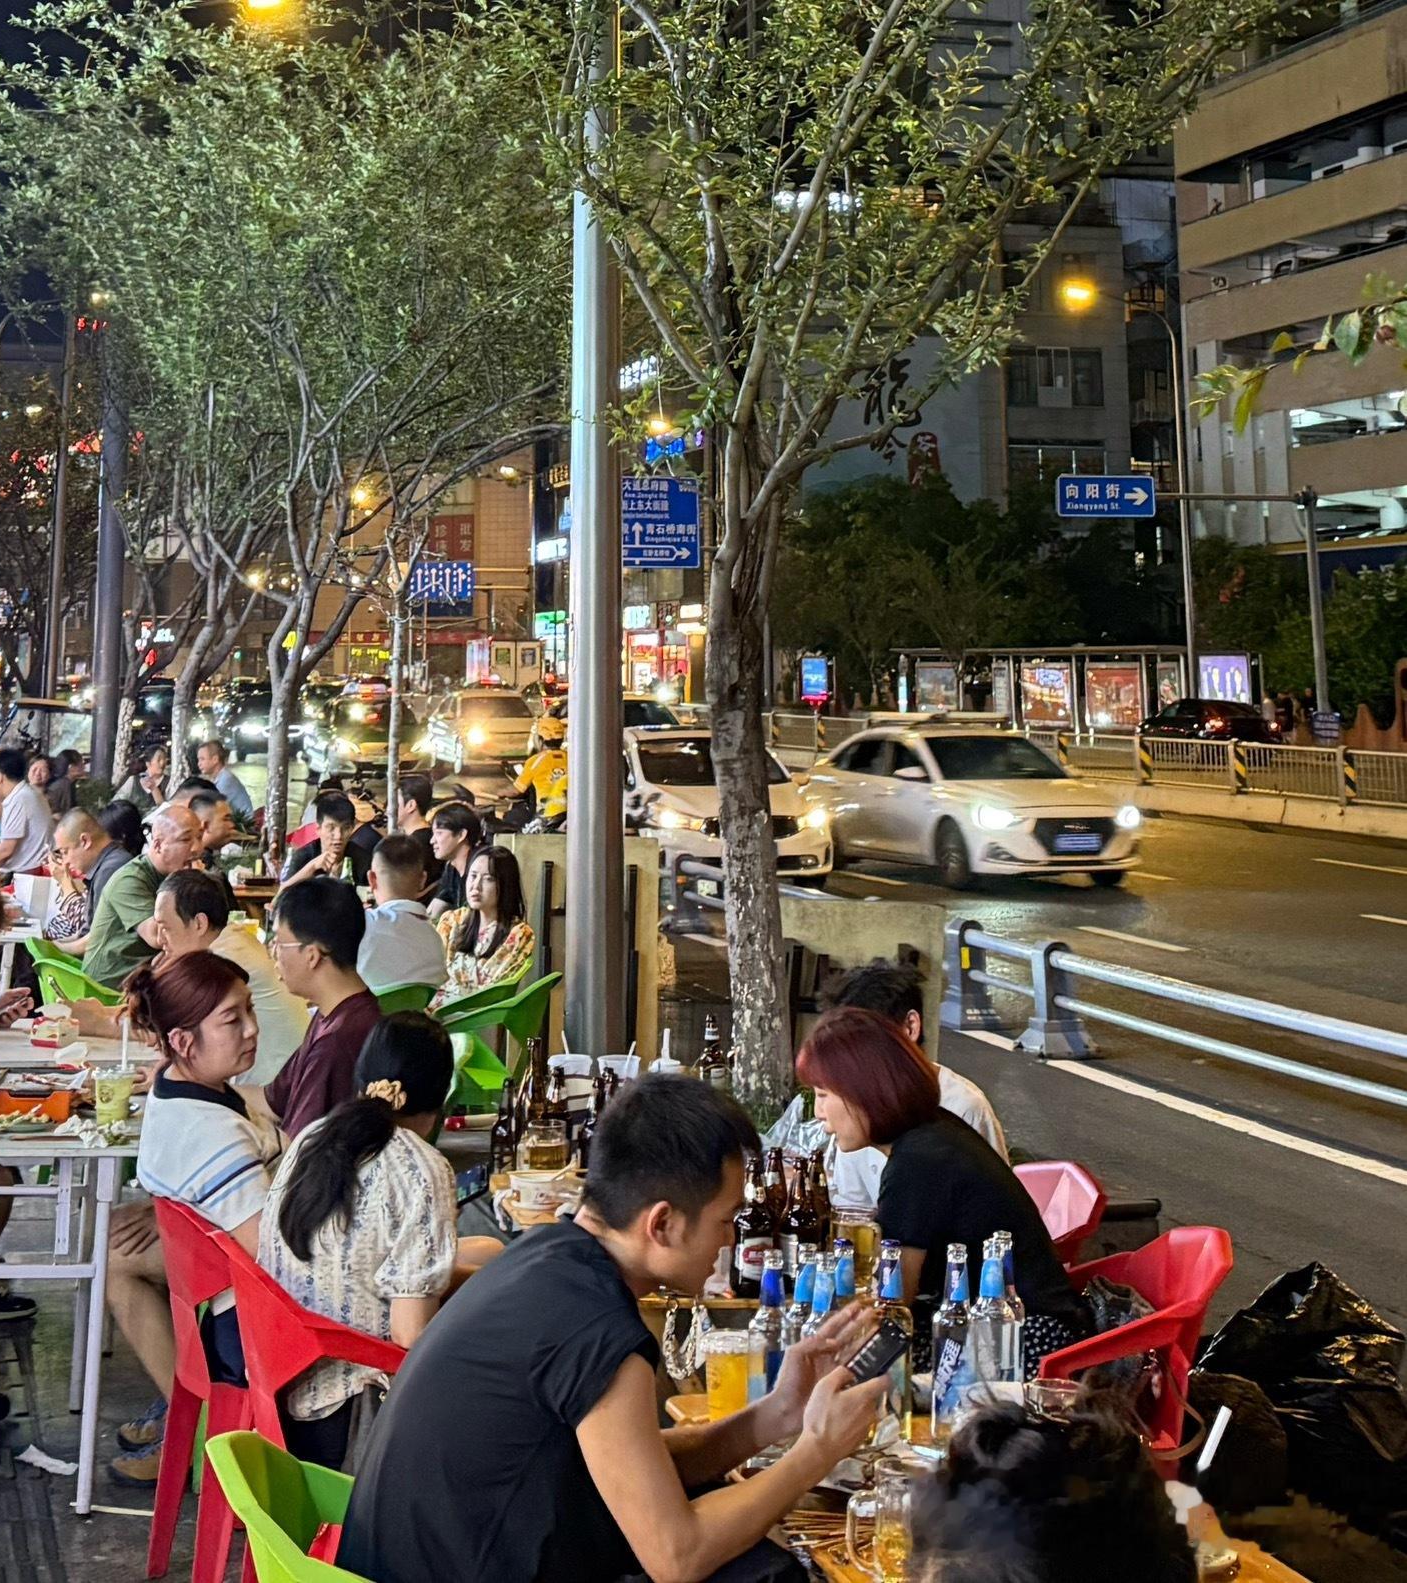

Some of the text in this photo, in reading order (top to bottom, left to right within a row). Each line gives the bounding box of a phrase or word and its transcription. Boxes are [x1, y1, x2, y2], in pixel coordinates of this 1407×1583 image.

[1065, 483, 1121, 499] 向阳街
[1065, 502, 1108, 512] Xiangyang
[459, 522, 473, 552] 批发
